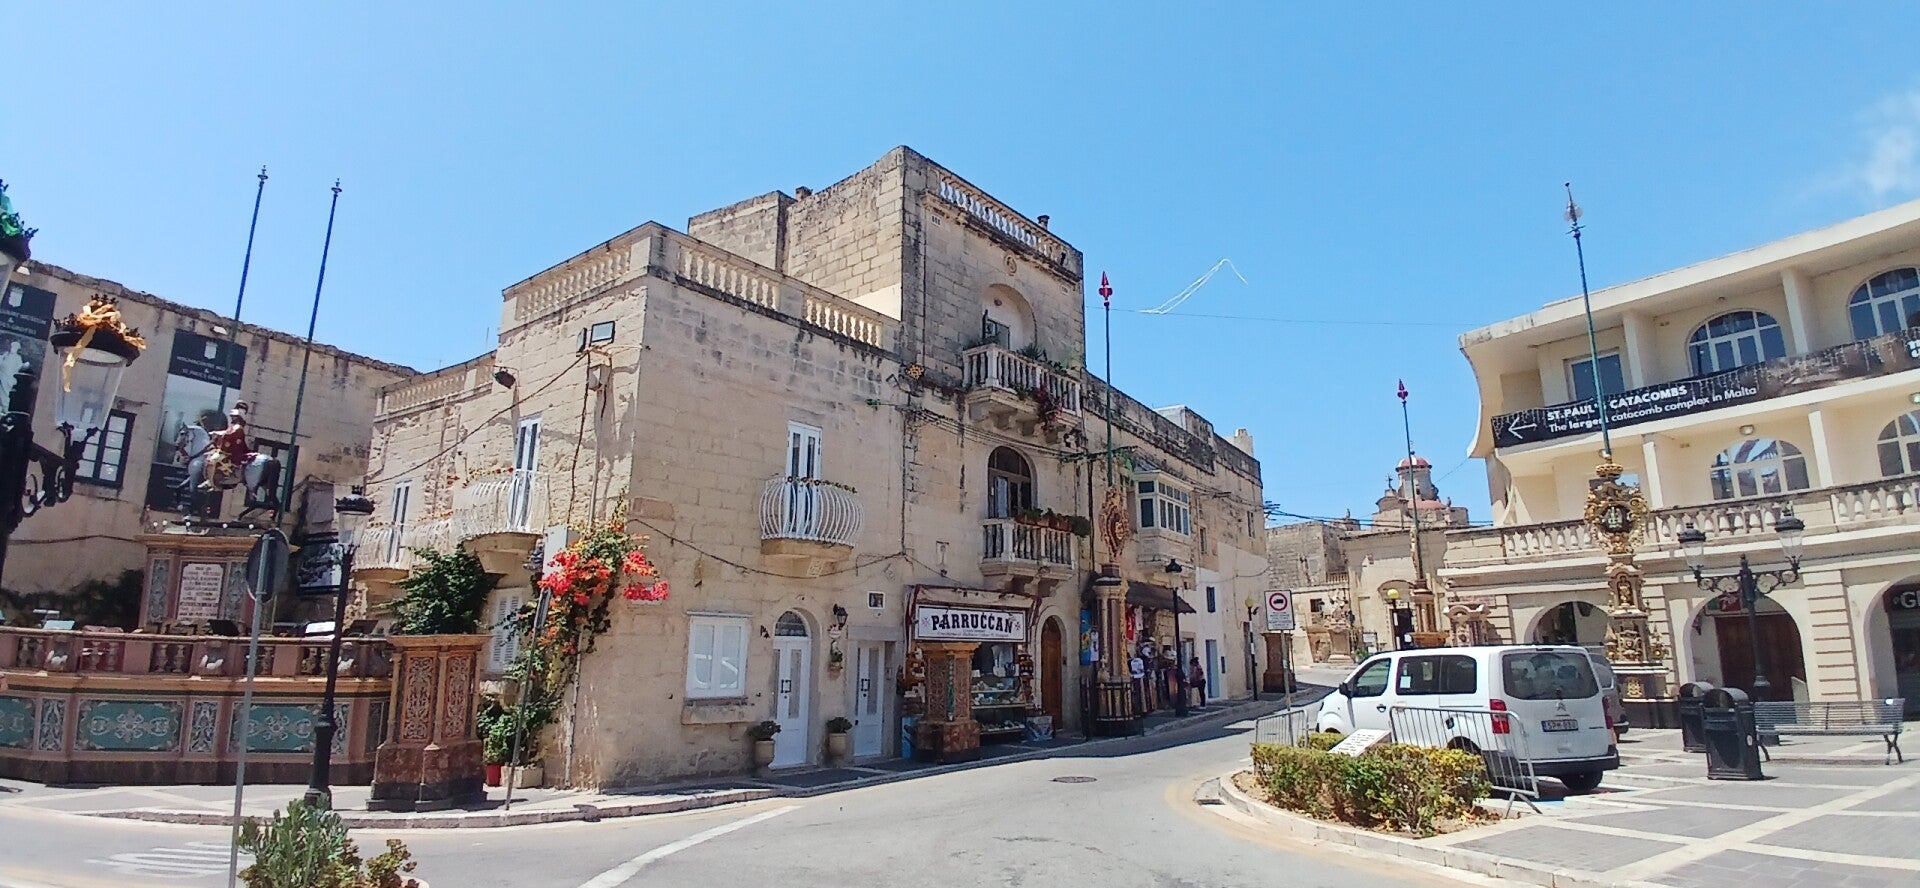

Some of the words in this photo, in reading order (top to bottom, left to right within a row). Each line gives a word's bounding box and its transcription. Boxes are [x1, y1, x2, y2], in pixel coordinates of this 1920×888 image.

[1549, 421, 1567, 433] The
[1611, 404, 1663, 421] catacomb
[1664, 396, 1710, 412] complex
[1712, 394, 1723, 402] in
[1724, 386, 1757, 400] Malta
[1609, 385, 1688, 409] CATACOMBS
